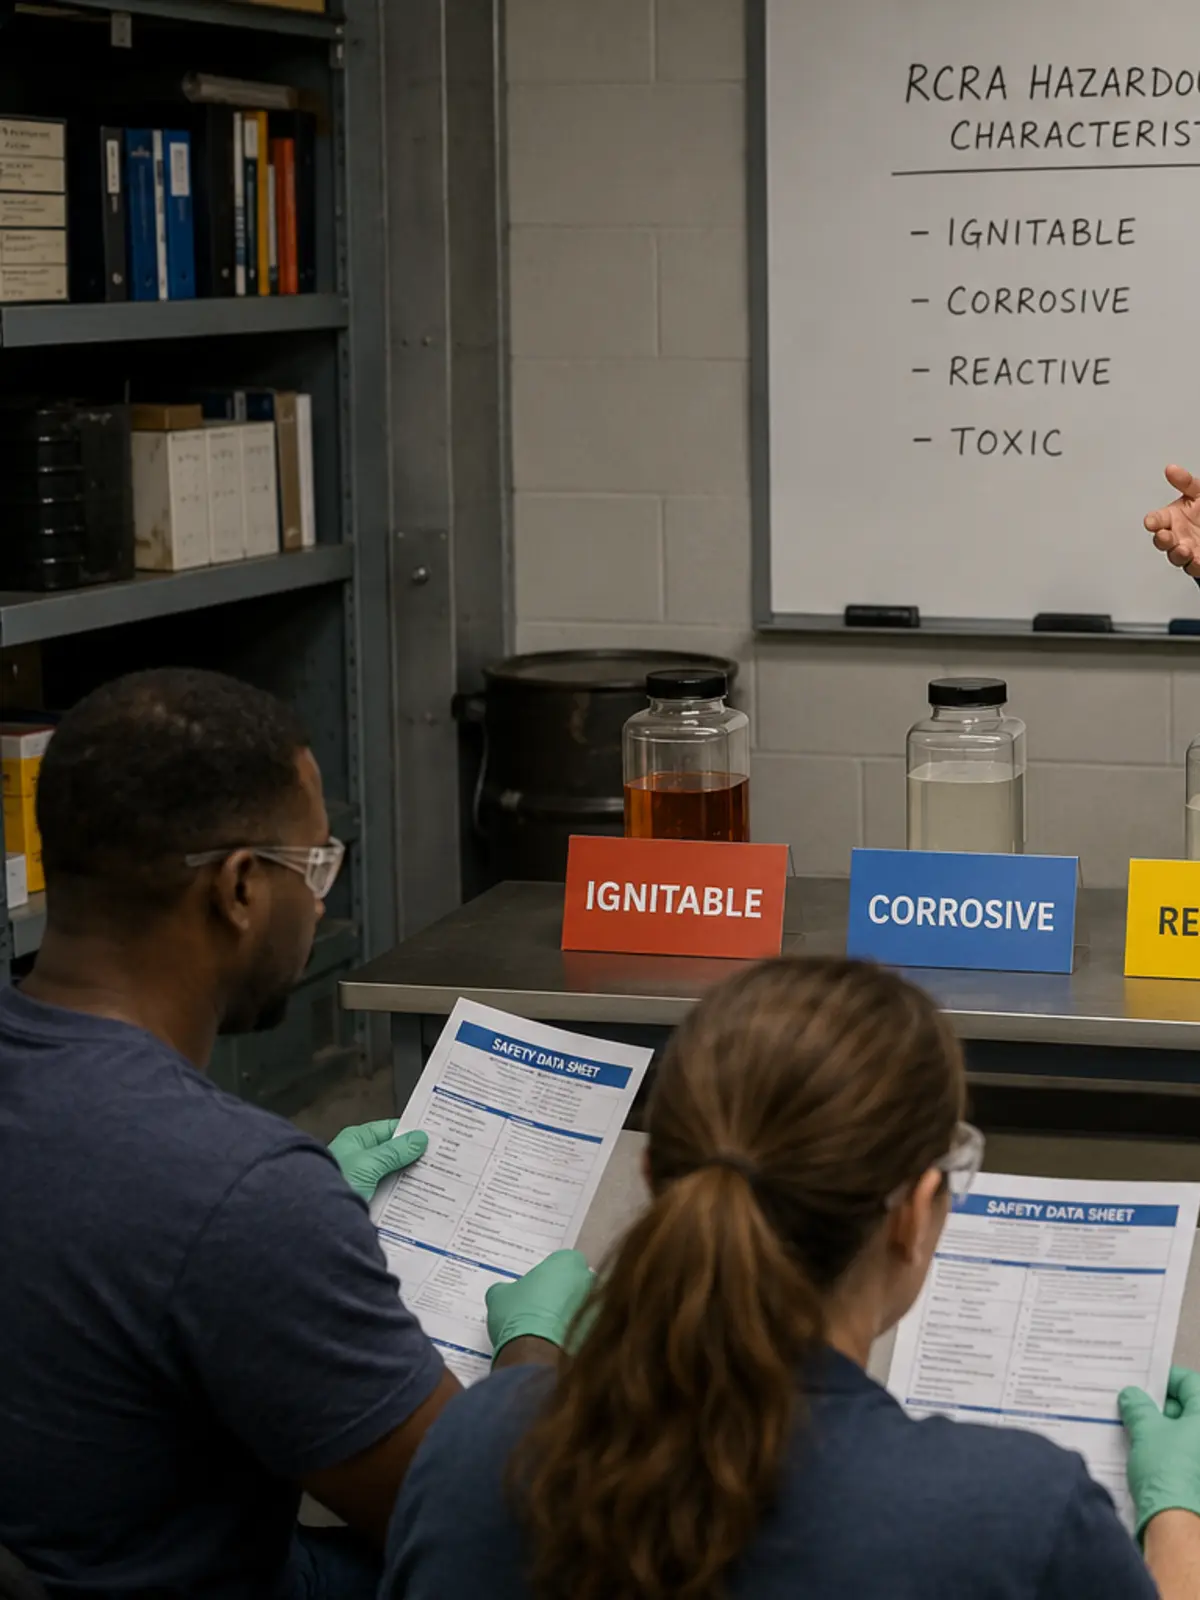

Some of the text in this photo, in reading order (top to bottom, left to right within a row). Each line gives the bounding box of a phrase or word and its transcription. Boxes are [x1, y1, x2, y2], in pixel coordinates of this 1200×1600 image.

[905, 64, 1007, 103] RCRA
[948, 217, 1137, 249] IGNITABLE
[946, 286, 1131, 316] CORROSIVE
[949, 356, 1111, 386] REACTIVE
[950, 427, 1064, 457] TOXIC
[586, 880, 763, 919] IGNITABLE
[868, 894, 1055, 932] CORROSIVE
[492, 1038, 601, 1079] SAFETY DATA SHEET
[986, 1200, 1135, 1222] SAFETY DATA SHEET
